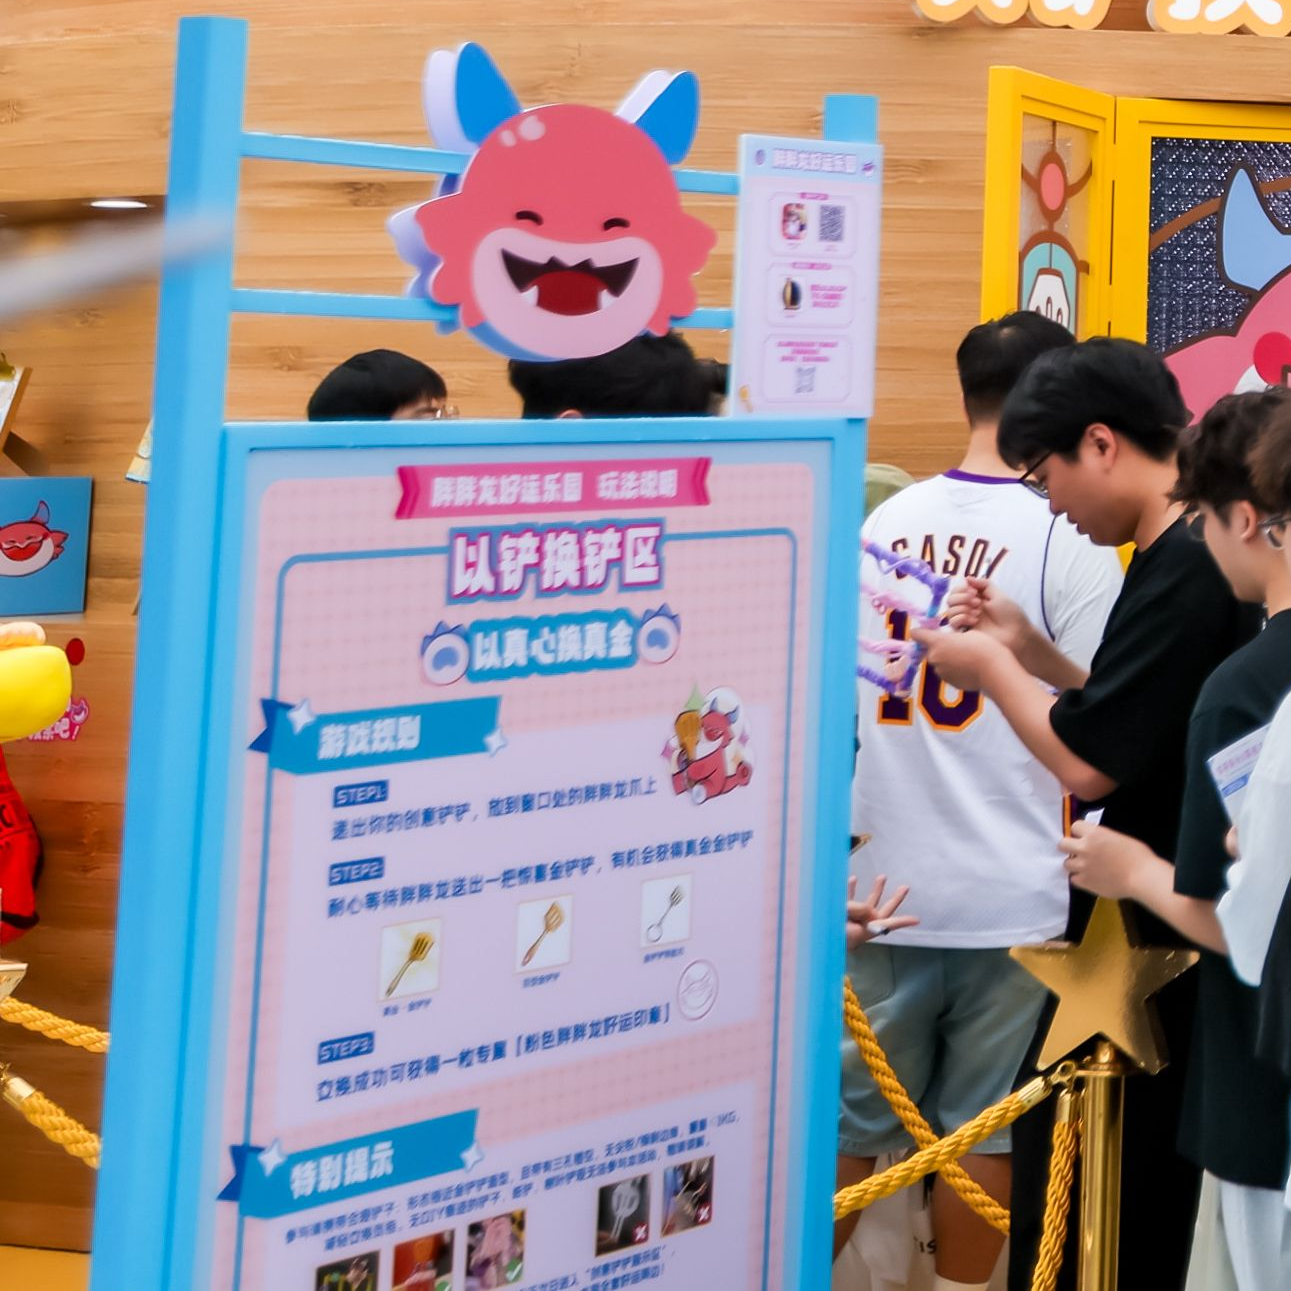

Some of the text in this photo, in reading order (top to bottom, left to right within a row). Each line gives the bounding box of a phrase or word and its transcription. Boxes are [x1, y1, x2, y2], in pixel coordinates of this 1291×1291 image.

[431, 469, 678, 508] 胖胖龙好运乐园 玩法说明
[452, 524, 662, 597] 以铲换铲区
[472, 619, 635, 671] 以真心换真金
[317, 714, 422, 761] 游戏规则
[289, 1140, 395, 1200] 特别提示
